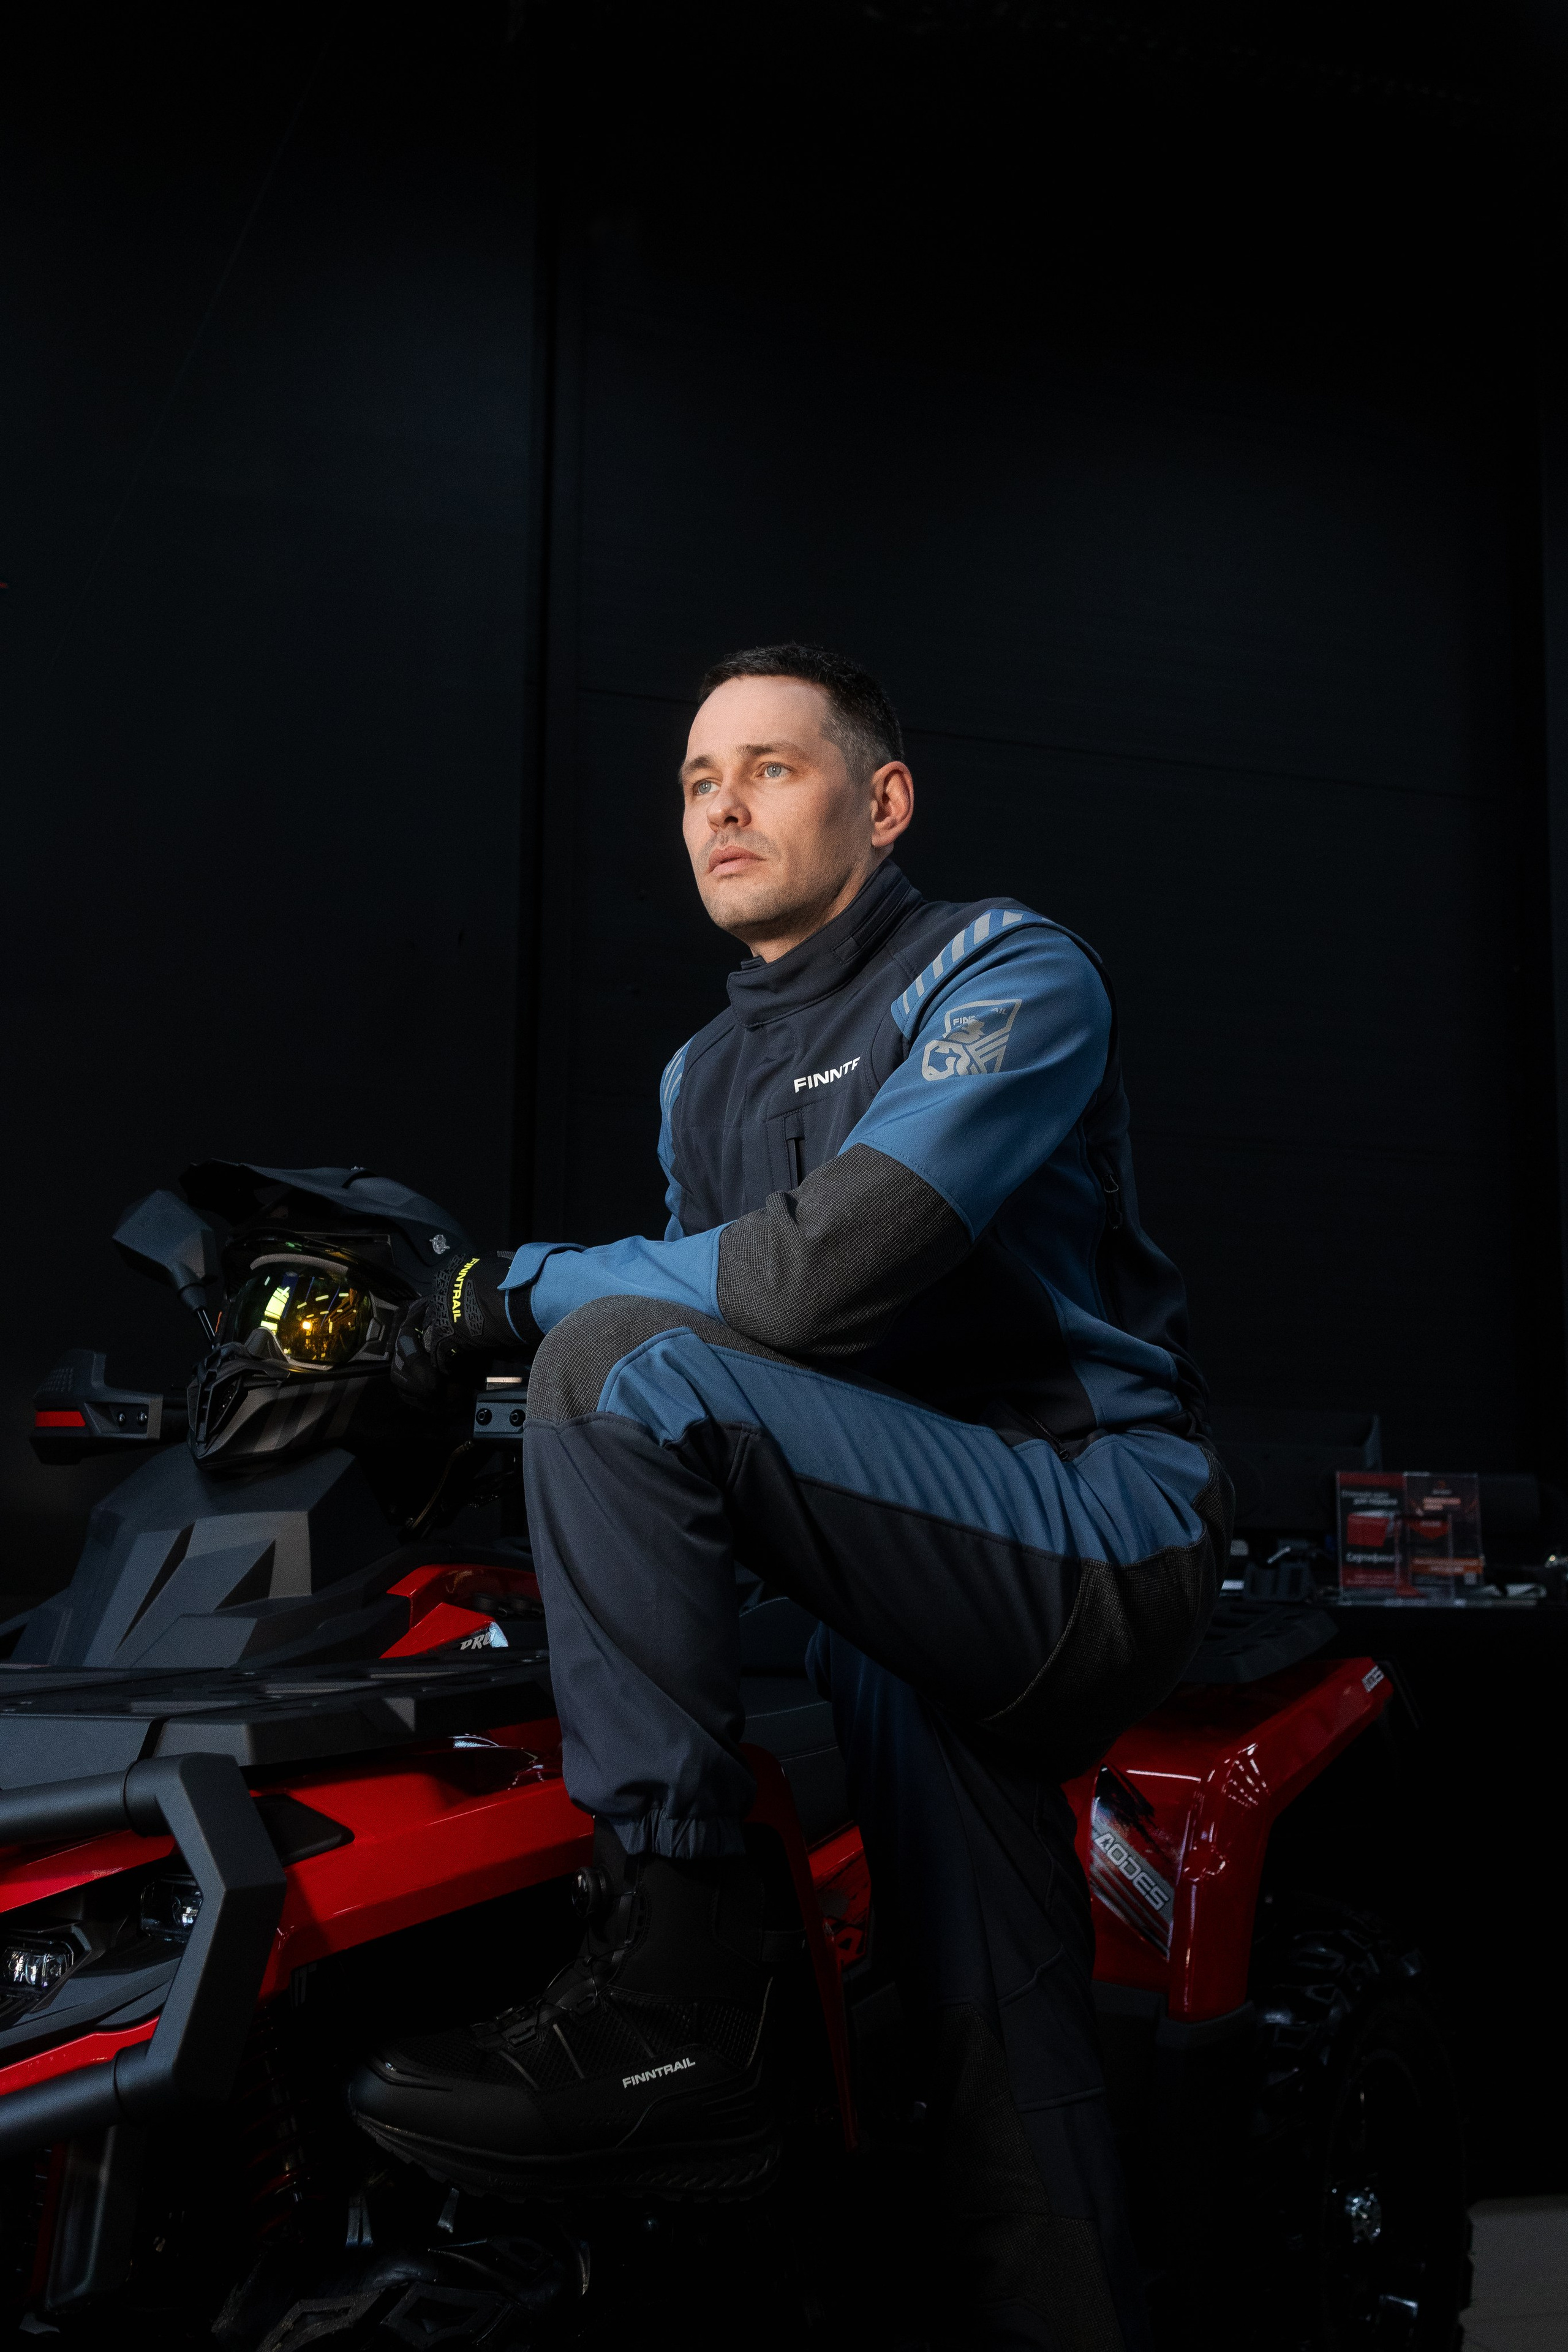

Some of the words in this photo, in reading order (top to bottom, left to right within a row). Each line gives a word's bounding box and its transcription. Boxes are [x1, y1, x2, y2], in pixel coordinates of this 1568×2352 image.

[451, 1257, 480, 1323] FINNTRAIL
[460, 1629, 497, 1650] PRO
[1095, 1832, 1170, 1912] AODES
[622, 2057, 696, 2089] FINNTRAIL
